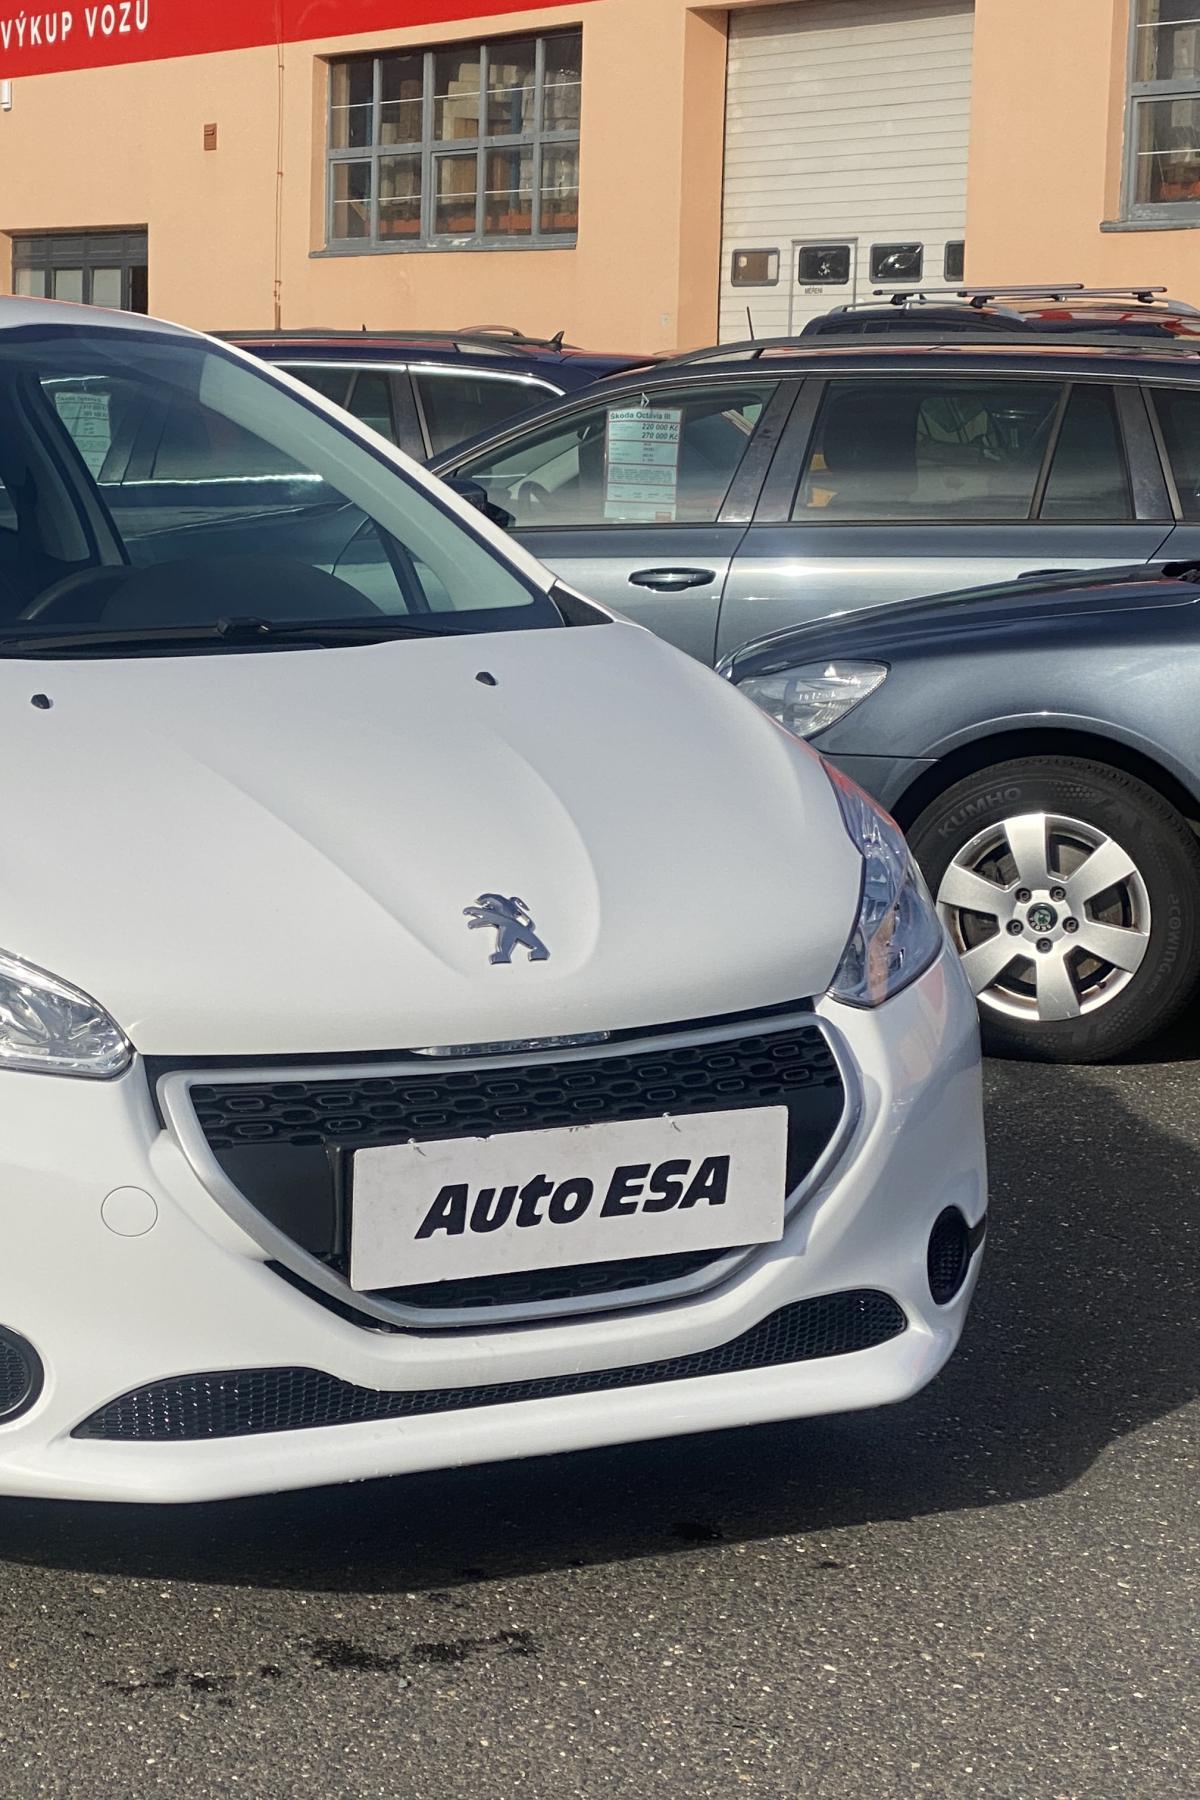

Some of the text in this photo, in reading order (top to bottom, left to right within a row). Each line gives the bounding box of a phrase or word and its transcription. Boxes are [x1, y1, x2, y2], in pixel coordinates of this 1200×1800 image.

[0, 10, 73, 49] VÝKUP
[938, 787, 1022, 838] KUMHO
[414, 1155, 731, 1239] Auto ESA
